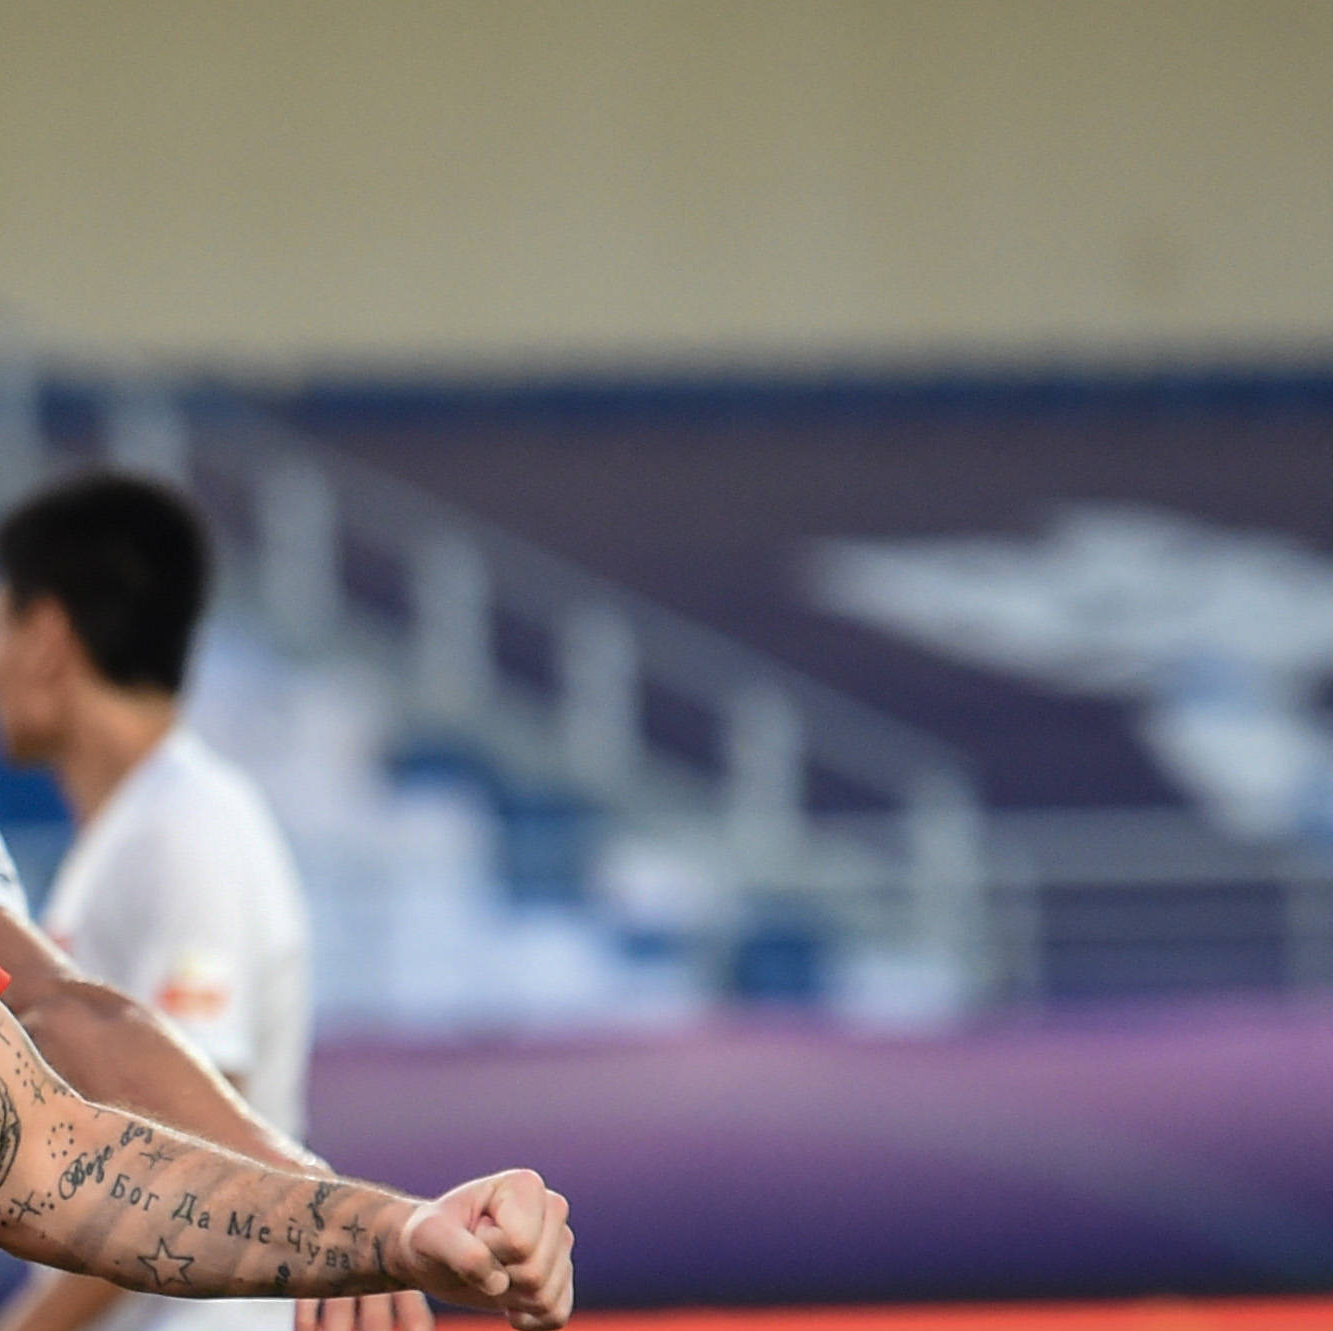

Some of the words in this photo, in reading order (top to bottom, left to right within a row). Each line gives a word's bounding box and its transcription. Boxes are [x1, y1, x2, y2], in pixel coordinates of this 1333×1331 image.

[110, 1173, 159, 1211] Бог
[171, 1192, 210, 1229] Да
[227, 1210, 271, 1244] Ме
